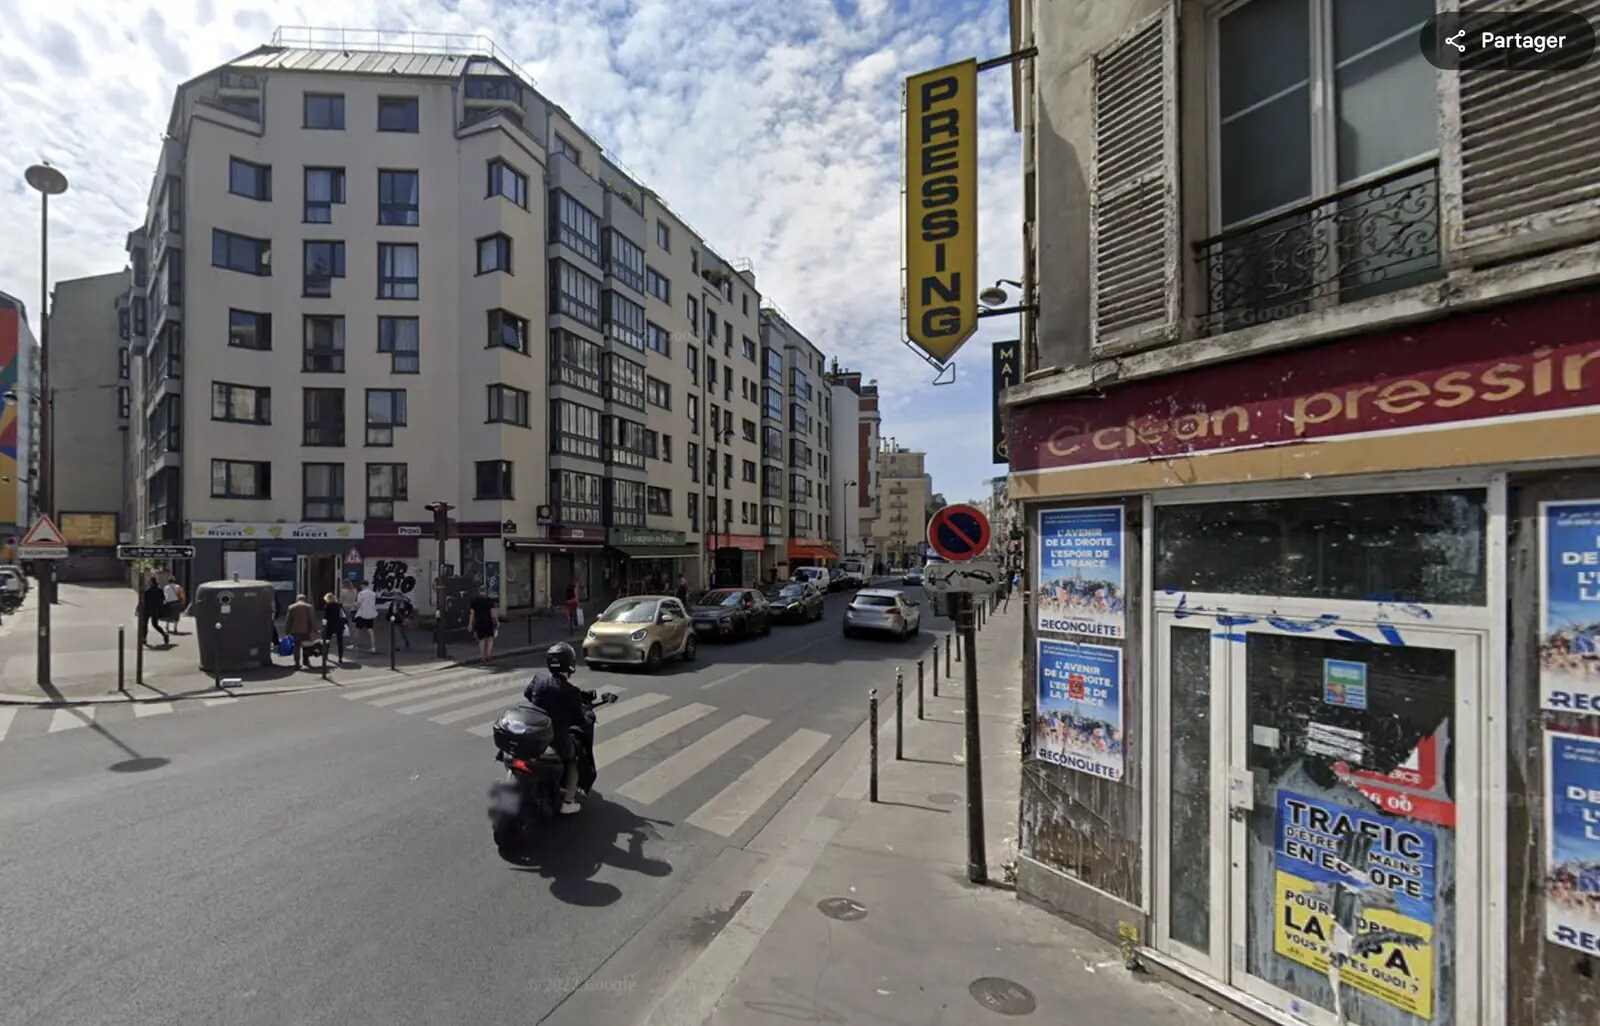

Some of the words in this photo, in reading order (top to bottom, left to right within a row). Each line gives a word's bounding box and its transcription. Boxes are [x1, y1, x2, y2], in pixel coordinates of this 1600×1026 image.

[921, 76, 961, 338] PRESSING
[292, 530, 328, 538] Nivert
[1057, 528, 1103, 538] L'AVENIR
[1045, 538, 1058, 547] DE
[1060, 538, 1073, 546] LA
[1050, 549, 1093, 558] L'ESPOIR
[1095, 549, 1110, 558] DE
[1562, 552, 1598, 565] DE
[1051, 559, 1064, 568] LA
[1066, 560, 1107, 568] FRANCE
[1044, 668, 1057, 678] DE
[1055, 660, 1101, 675] L'AVENIR
[1050, 690, 1062, 699] LA
[1093, 688, 1108, 699] DE
[1286, 800, 1421, 859] TRAFIC
[1286, 841, 1315, 863] EN
[1284, 889, 1329, 915] POUR
[1284, 905, 1326, 941] LA
[1284, 931, 1318, 951] VOUS
[1371, 967, 1407, 990] QUOI
